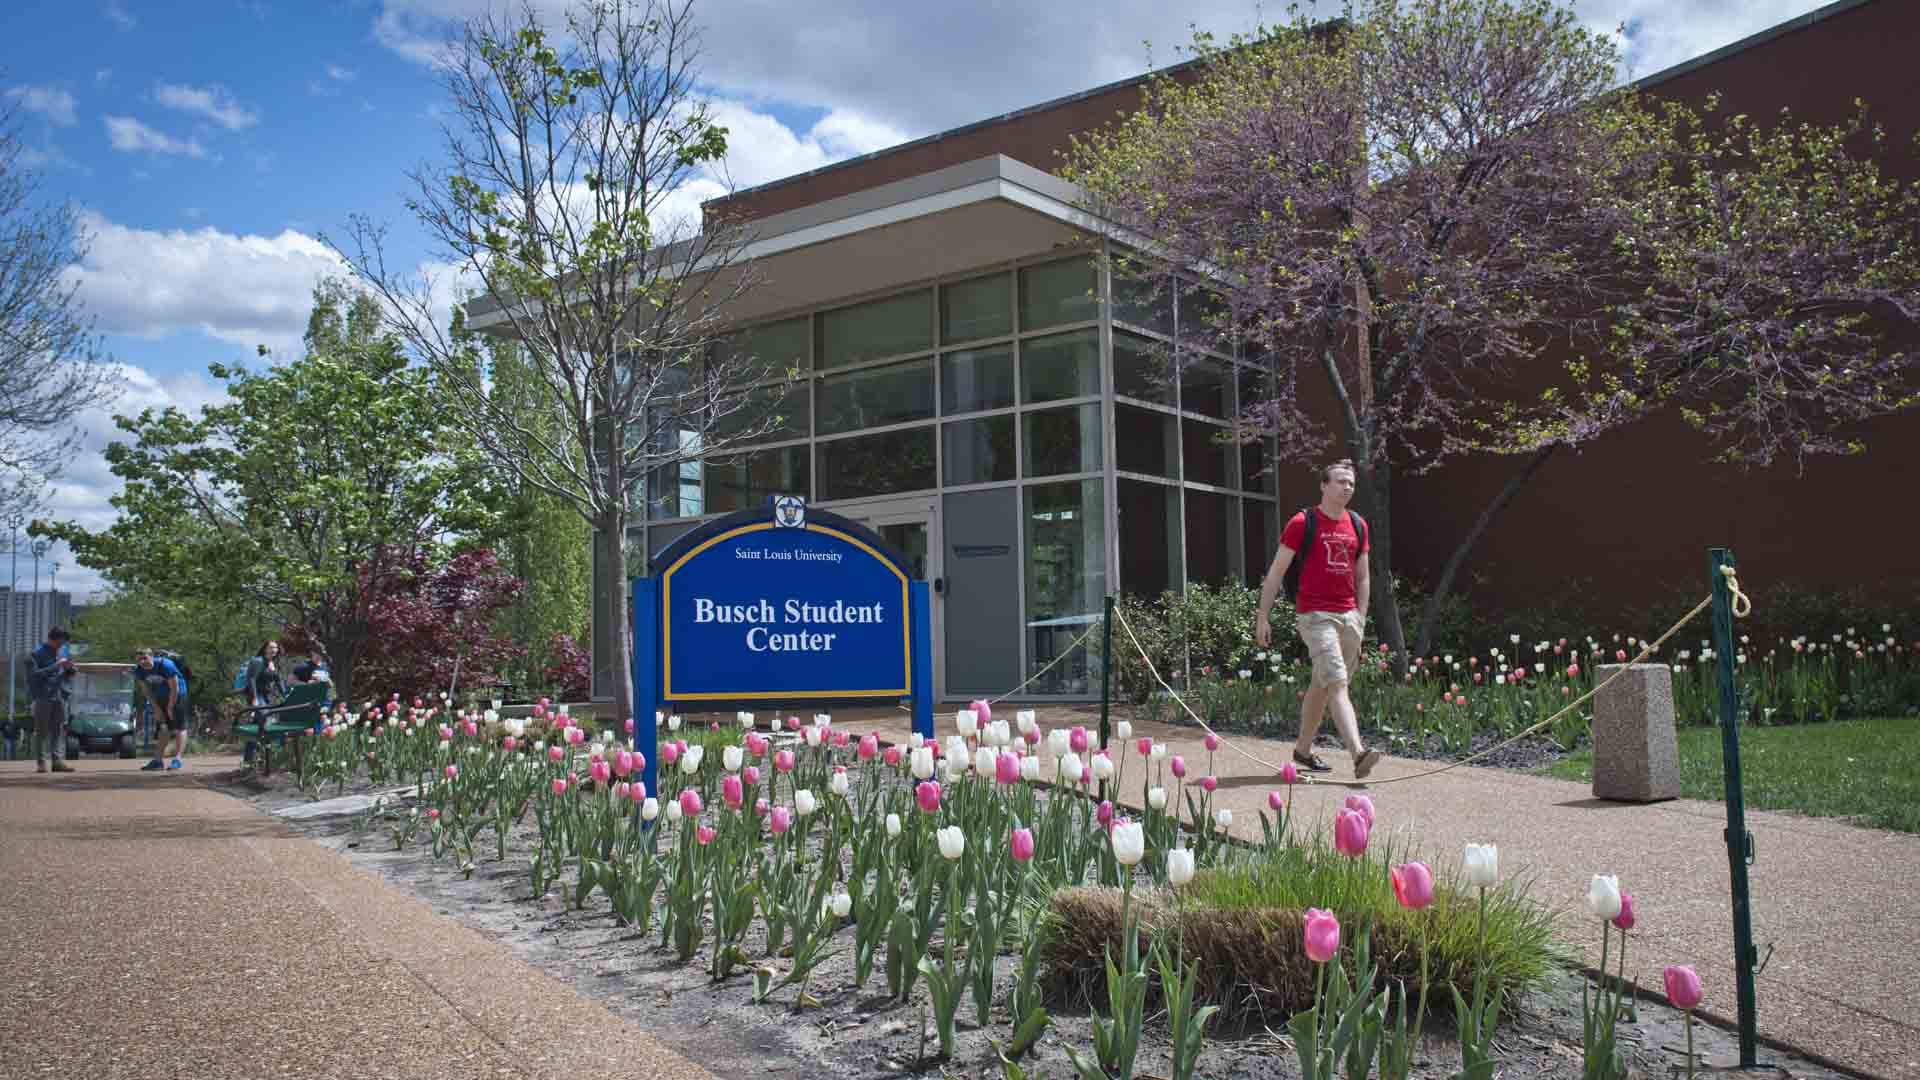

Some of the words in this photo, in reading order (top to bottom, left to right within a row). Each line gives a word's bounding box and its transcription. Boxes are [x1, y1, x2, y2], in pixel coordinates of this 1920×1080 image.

[735, 548, 761, 560] Saint
[764, 548, 792, 560] Louis
[795, 549, 843, 563] University
[695, 598, 776, 624] Busch
[784, 599, 884, 624] Student
[746, 627, 836, 652] Center
